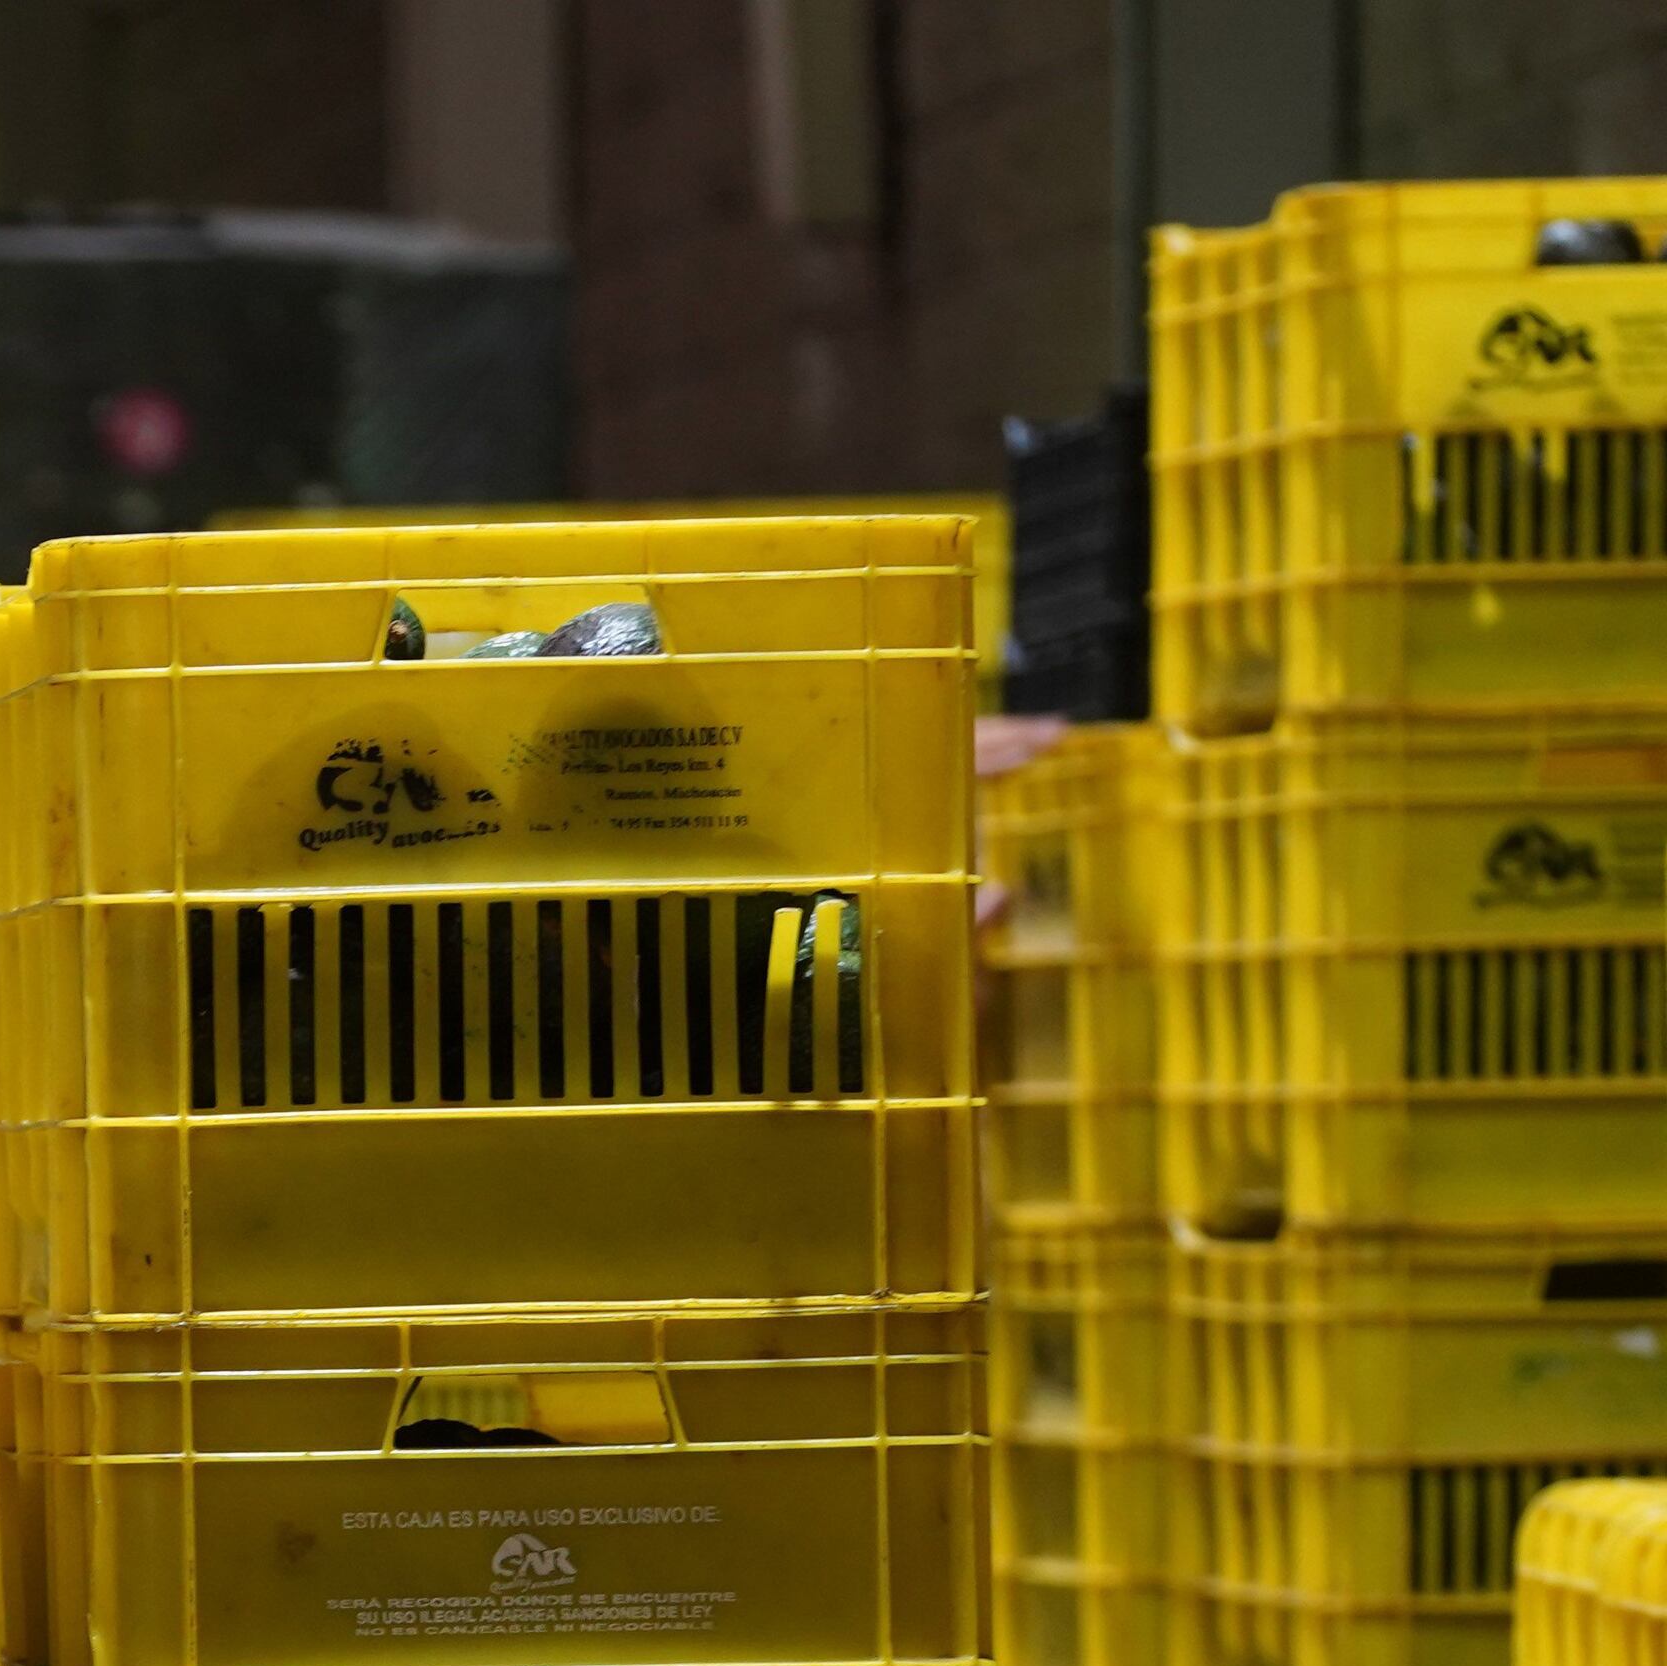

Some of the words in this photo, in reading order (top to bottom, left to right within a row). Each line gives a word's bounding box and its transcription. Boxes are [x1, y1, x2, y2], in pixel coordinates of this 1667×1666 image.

[298, 821, 390, 851] Quality
[341, 1510, 392, 1530] ESTA
[395, 1510, 444, 1529] CAJA
[448, 1509, 473, 1528] ES
[477, 1508, 530, 1527] PARA
[534, 1507, 576, 1526] USO
[578, 1506, 686, 1526] EXCLUSIVO
[387, 1596, 497, 1609] RECOGIDA
[501, 1595, 574, 1607] DONDE
[579, 1594, 607, 1605] SE
[611, 1591, 737, 1605] ENCUENTRE
[356, 1611, 379, 1625] SU
[382, 1610, 417, 1625] USO
[419, 1609, 478, 1624] ILEGAL
[479, 1608, 558, 1623] ACARREA
[560, 1606, 652, 1621] SANCIONES
[656, 1605, 678, 1619] DE
[355, 1627, 385, 1637] NO
[391, 1626, 419, 1636] ES
